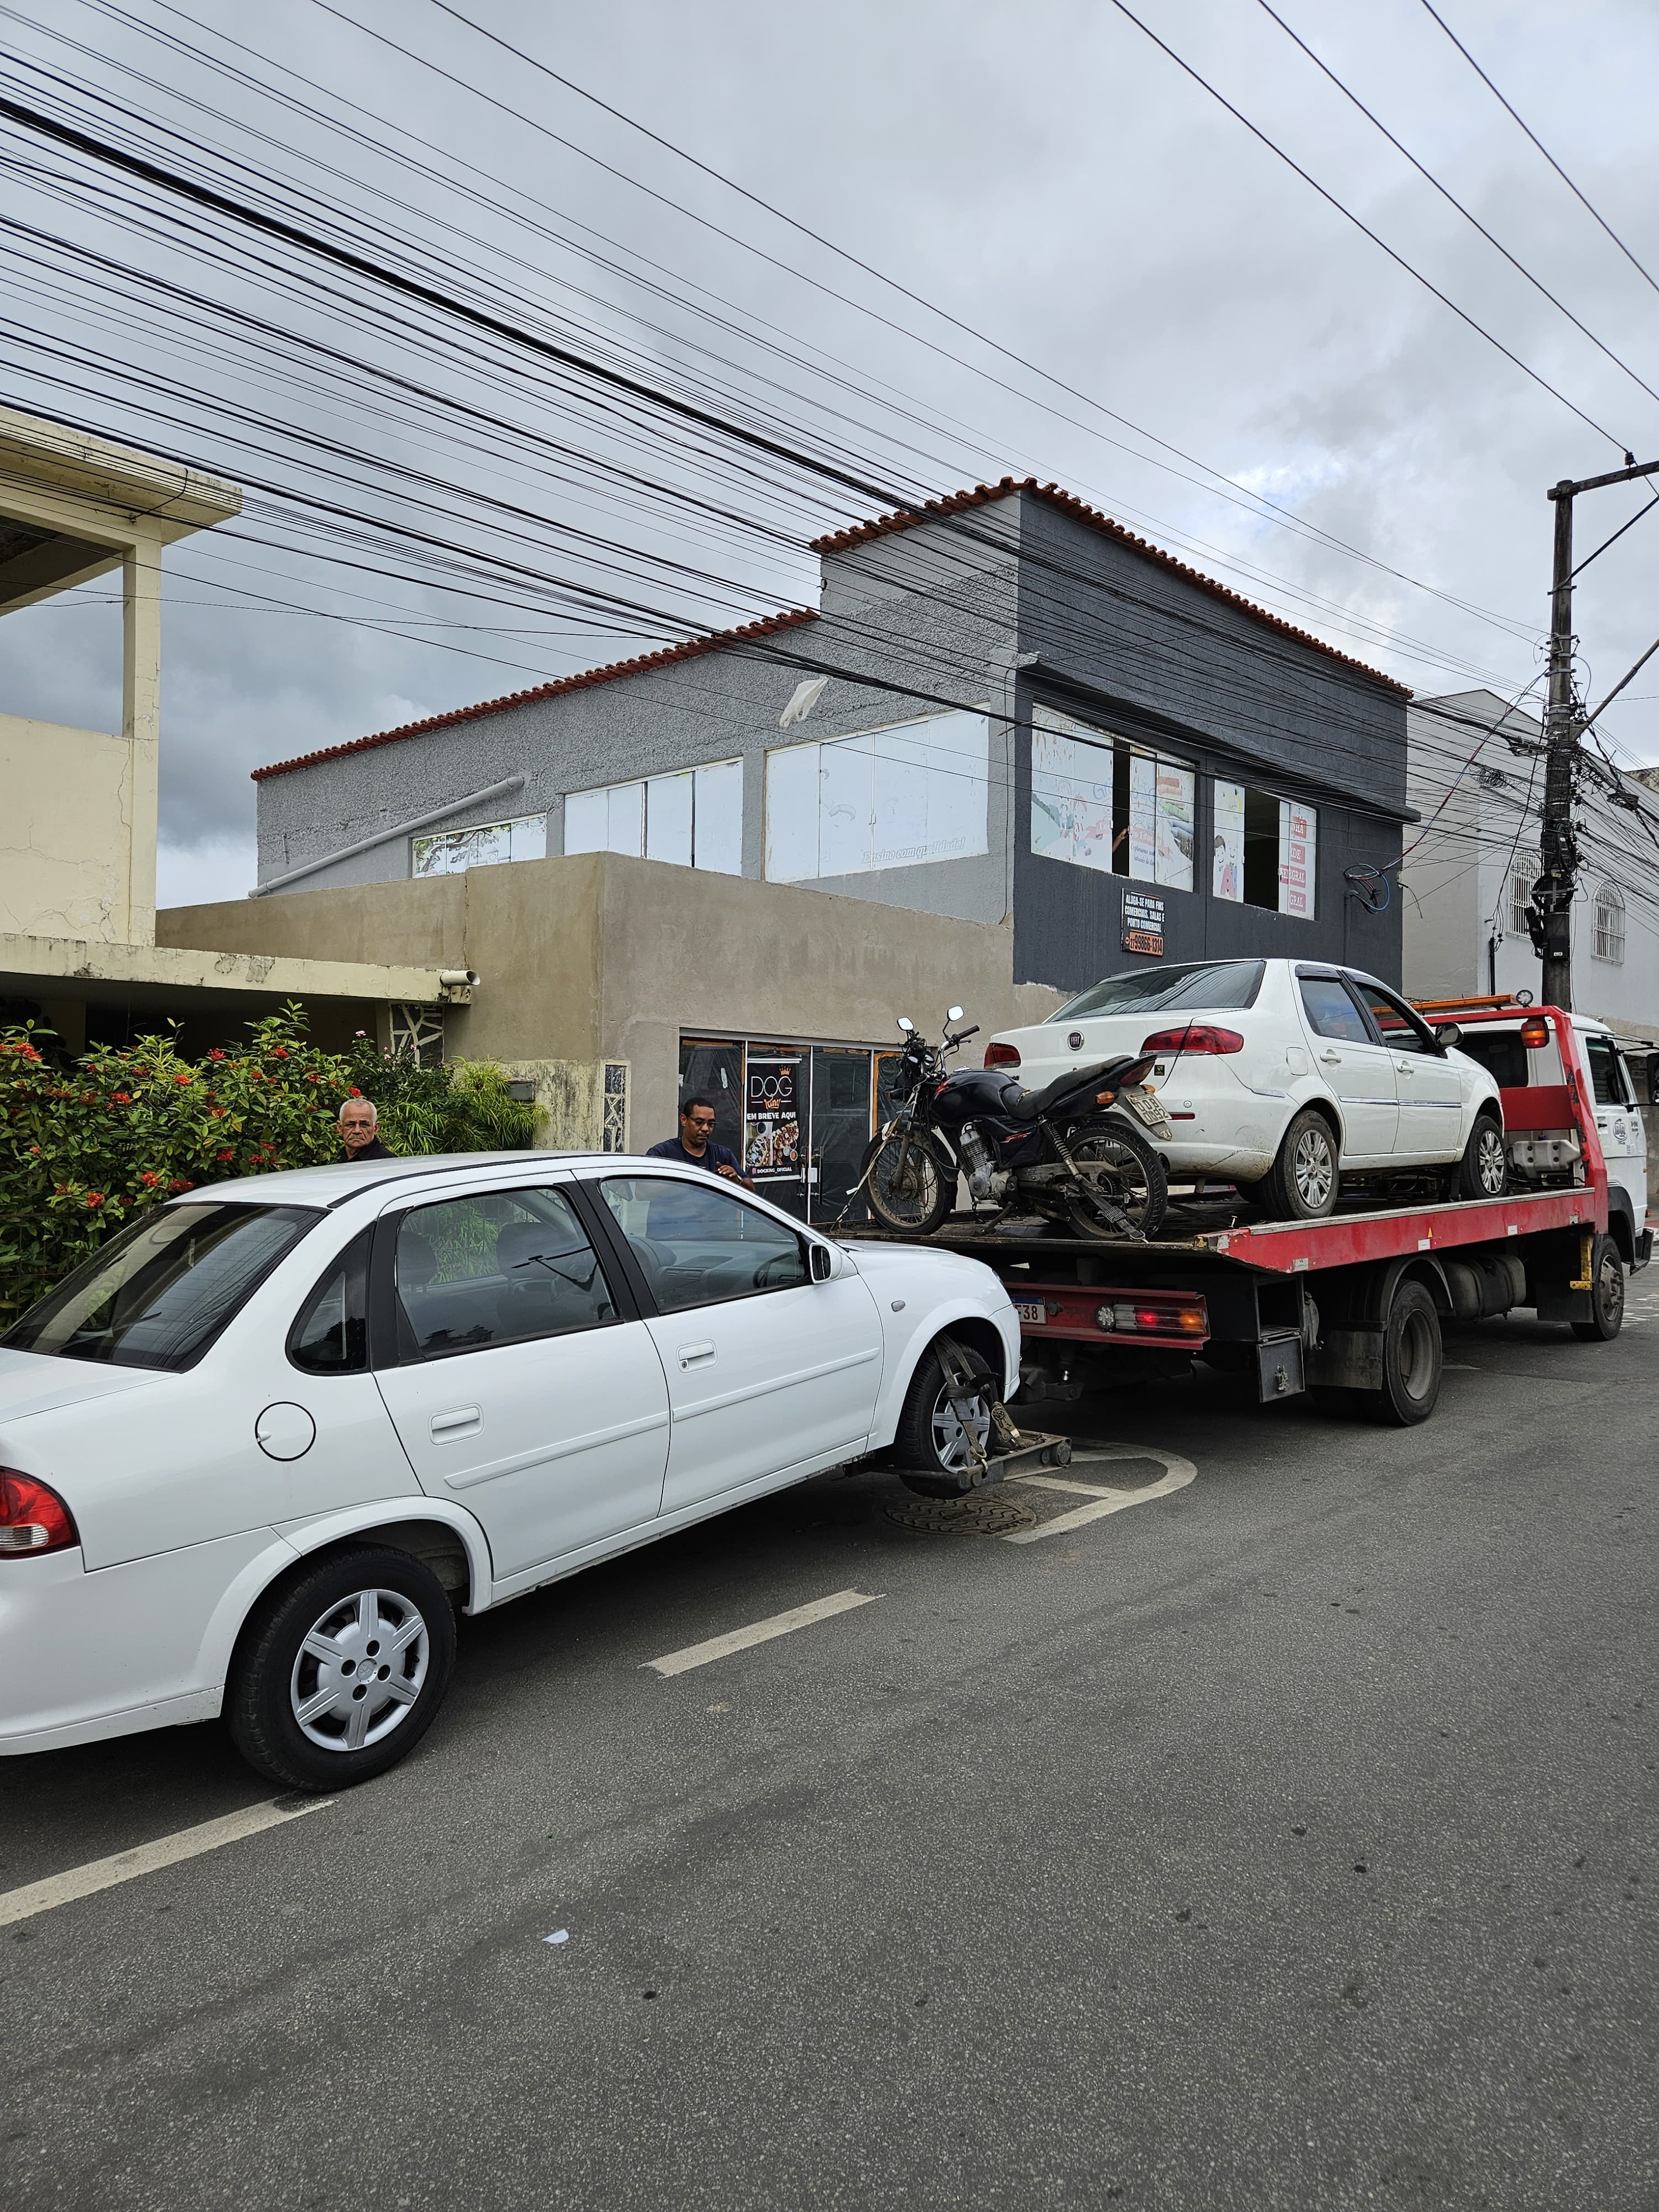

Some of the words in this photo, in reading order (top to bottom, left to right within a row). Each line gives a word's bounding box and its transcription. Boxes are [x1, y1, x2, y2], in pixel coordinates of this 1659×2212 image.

[862, 849, 895, 863] Ensino
[896, 847, 915, 858] com
[916, 837, 966, 859] qualidade!
[1126, 894, 1144, 907] ALUGA-SE
[1145, 898, 1155, 909] PARA
[1155, 901, 1164, 911] FINS
[1150, 911, 1161, 921] SALAS
[1162, 913, 1165, 922] E
[1128, 917, 1140, 928] PONTO
[1140, 920, 1161, 932] COMERCIAL
[1071, 1036, 1080, 1045] FIAT
[751, 1076, 792, 1097] DOG
[781, 1111, 796, 1120] AQUI
